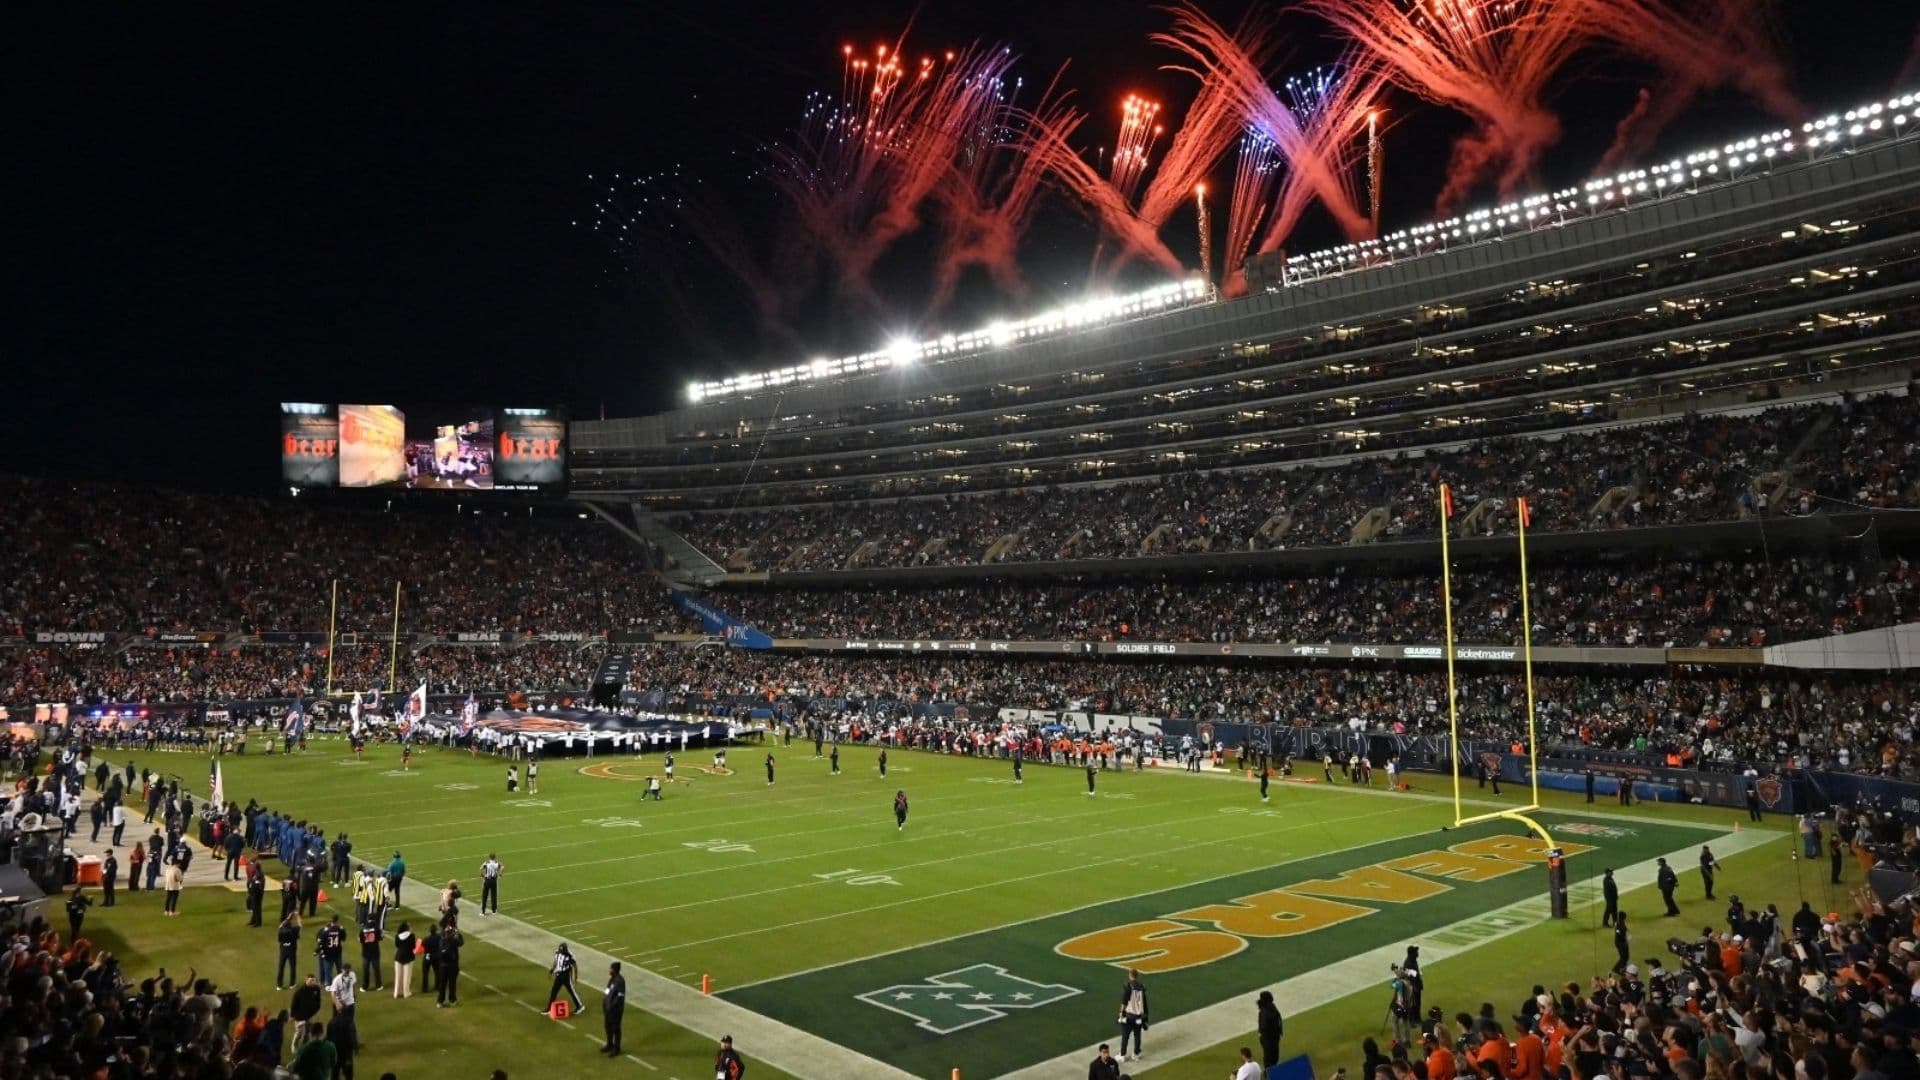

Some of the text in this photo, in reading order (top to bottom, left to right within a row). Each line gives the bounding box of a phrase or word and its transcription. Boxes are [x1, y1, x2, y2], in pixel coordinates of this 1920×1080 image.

[36, 632, 105, 642] DOWN
[457, 633, 500, 642] BEAR
[1116, 644, 1176, 654] SOLDIER FIELD
[1457, 648, 1516, 659] ticketmaster
[811, 868, 892, 886] 10
[1054, 834, 1600, 974] BEARS
[327, 935, 340, 949] 34
[555, 1003, 566, 1017] G
